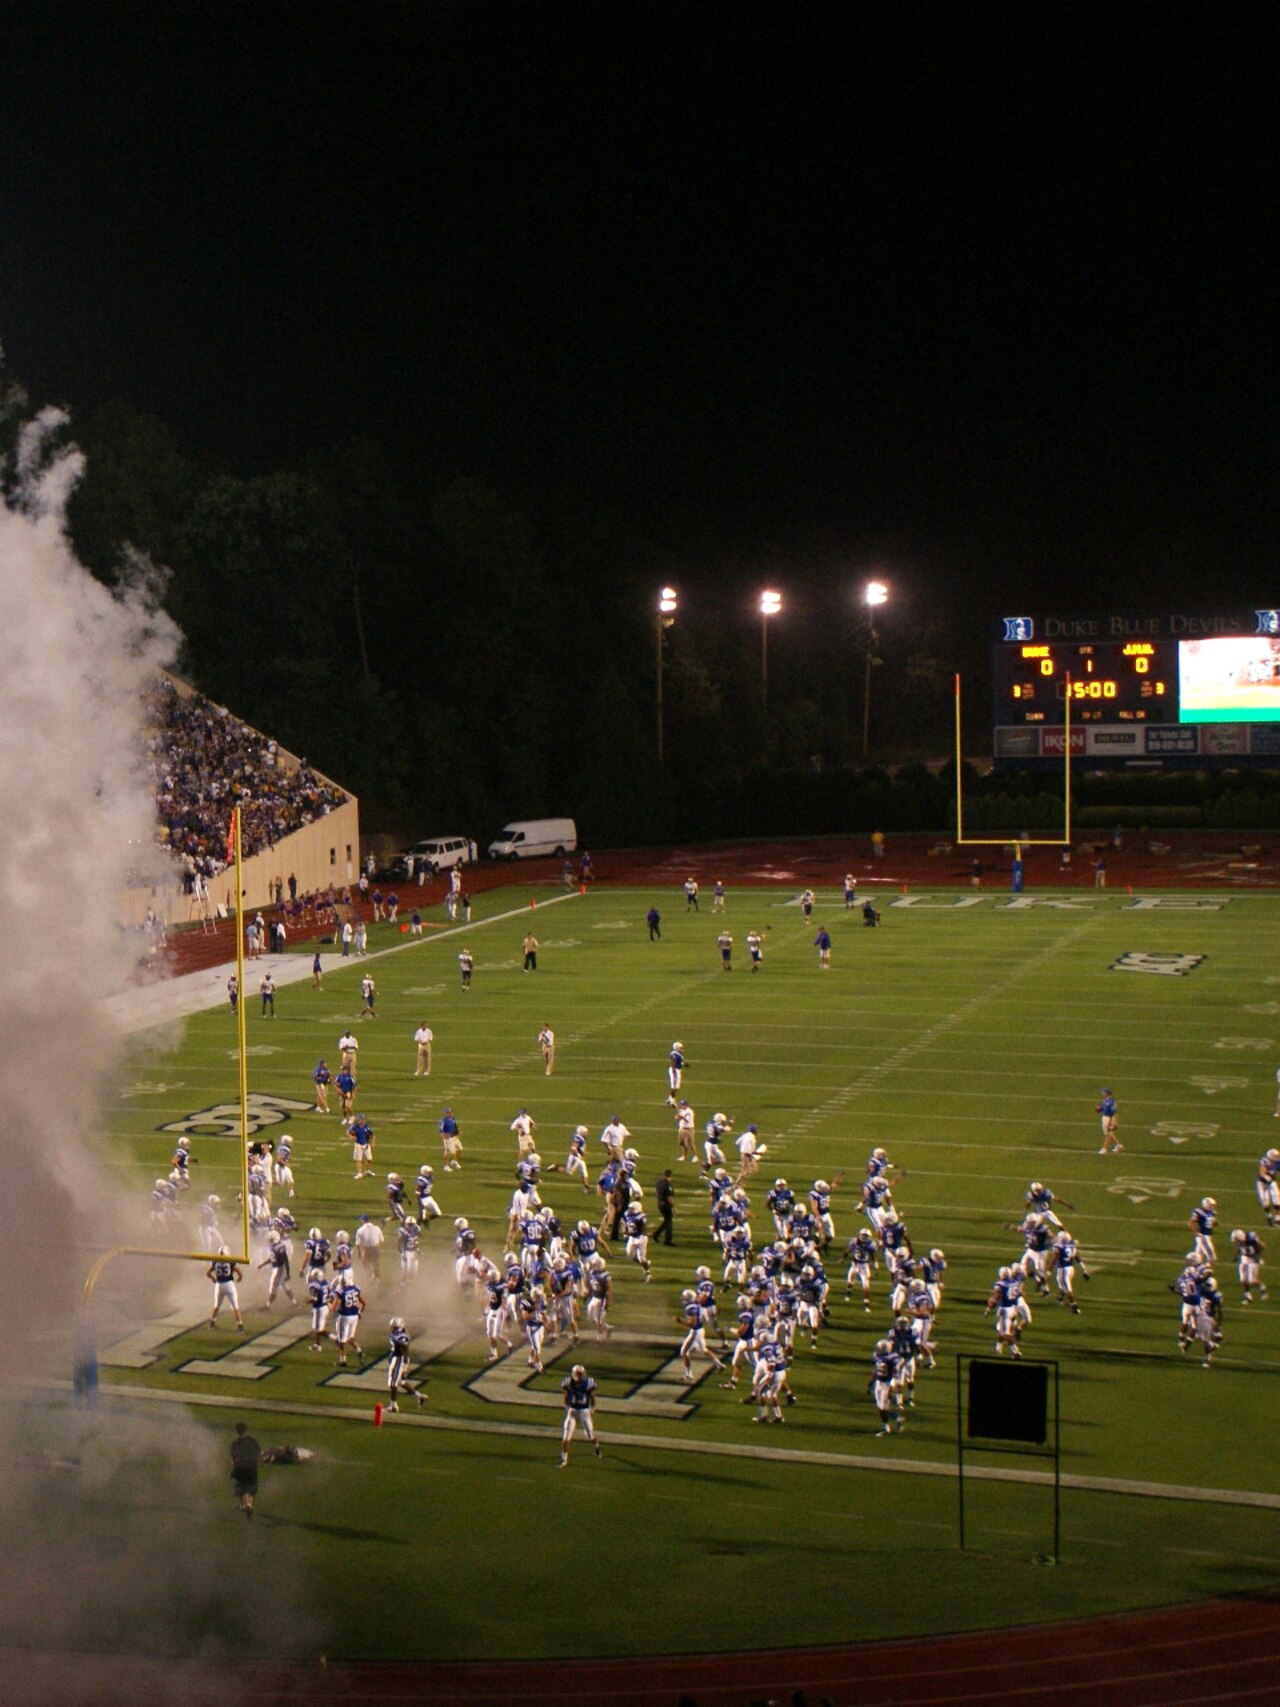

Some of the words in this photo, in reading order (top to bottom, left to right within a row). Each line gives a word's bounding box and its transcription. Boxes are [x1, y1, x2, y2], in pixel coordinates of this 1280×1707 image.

[1045, 618, 1099, 637] DUKE
[1110, 616, 1160, 635] BLUE
[1170, 614, 1240, 633] DEVILS
[1041, 659, 1053, 675] 0
[1135, 657, 1148, 673] 0
[1066, 682, 1116, 698] 15:00
[345, 1293, 360, 1308] 65
